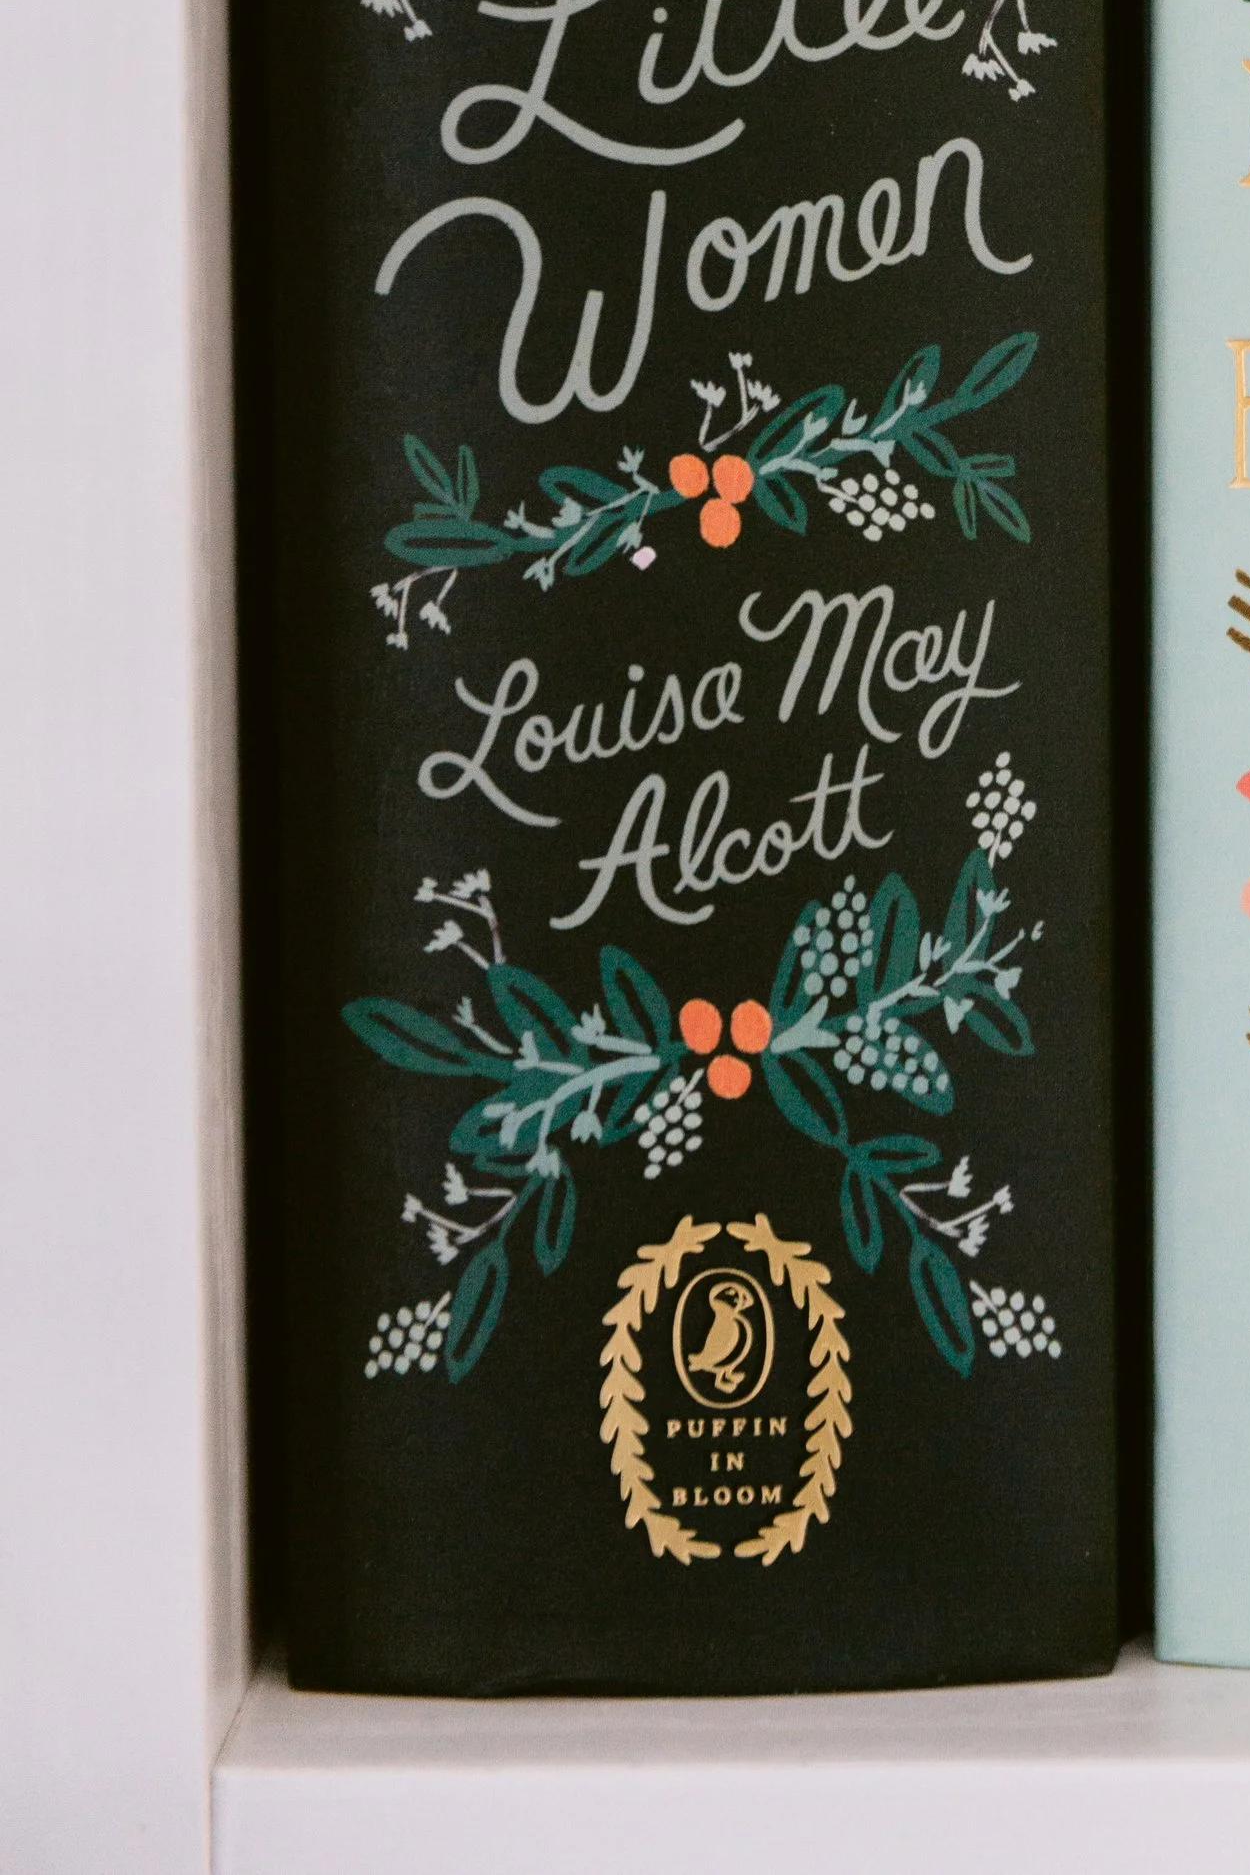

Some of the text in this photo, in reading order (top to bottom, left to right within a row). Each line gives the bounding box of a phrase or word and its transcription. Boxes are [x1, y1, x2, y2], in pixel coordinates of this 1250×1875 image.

[375, 137, 1033, 425] Women
[418, 585, 1021, 826] Louisa May
[550, 744, 894, 929] Alcott
[666, 1417, 788, 1438] PUFFIN
[709, 1452, 745, 1472] IN
[672, 1485, 784, 1506] BLOOM
